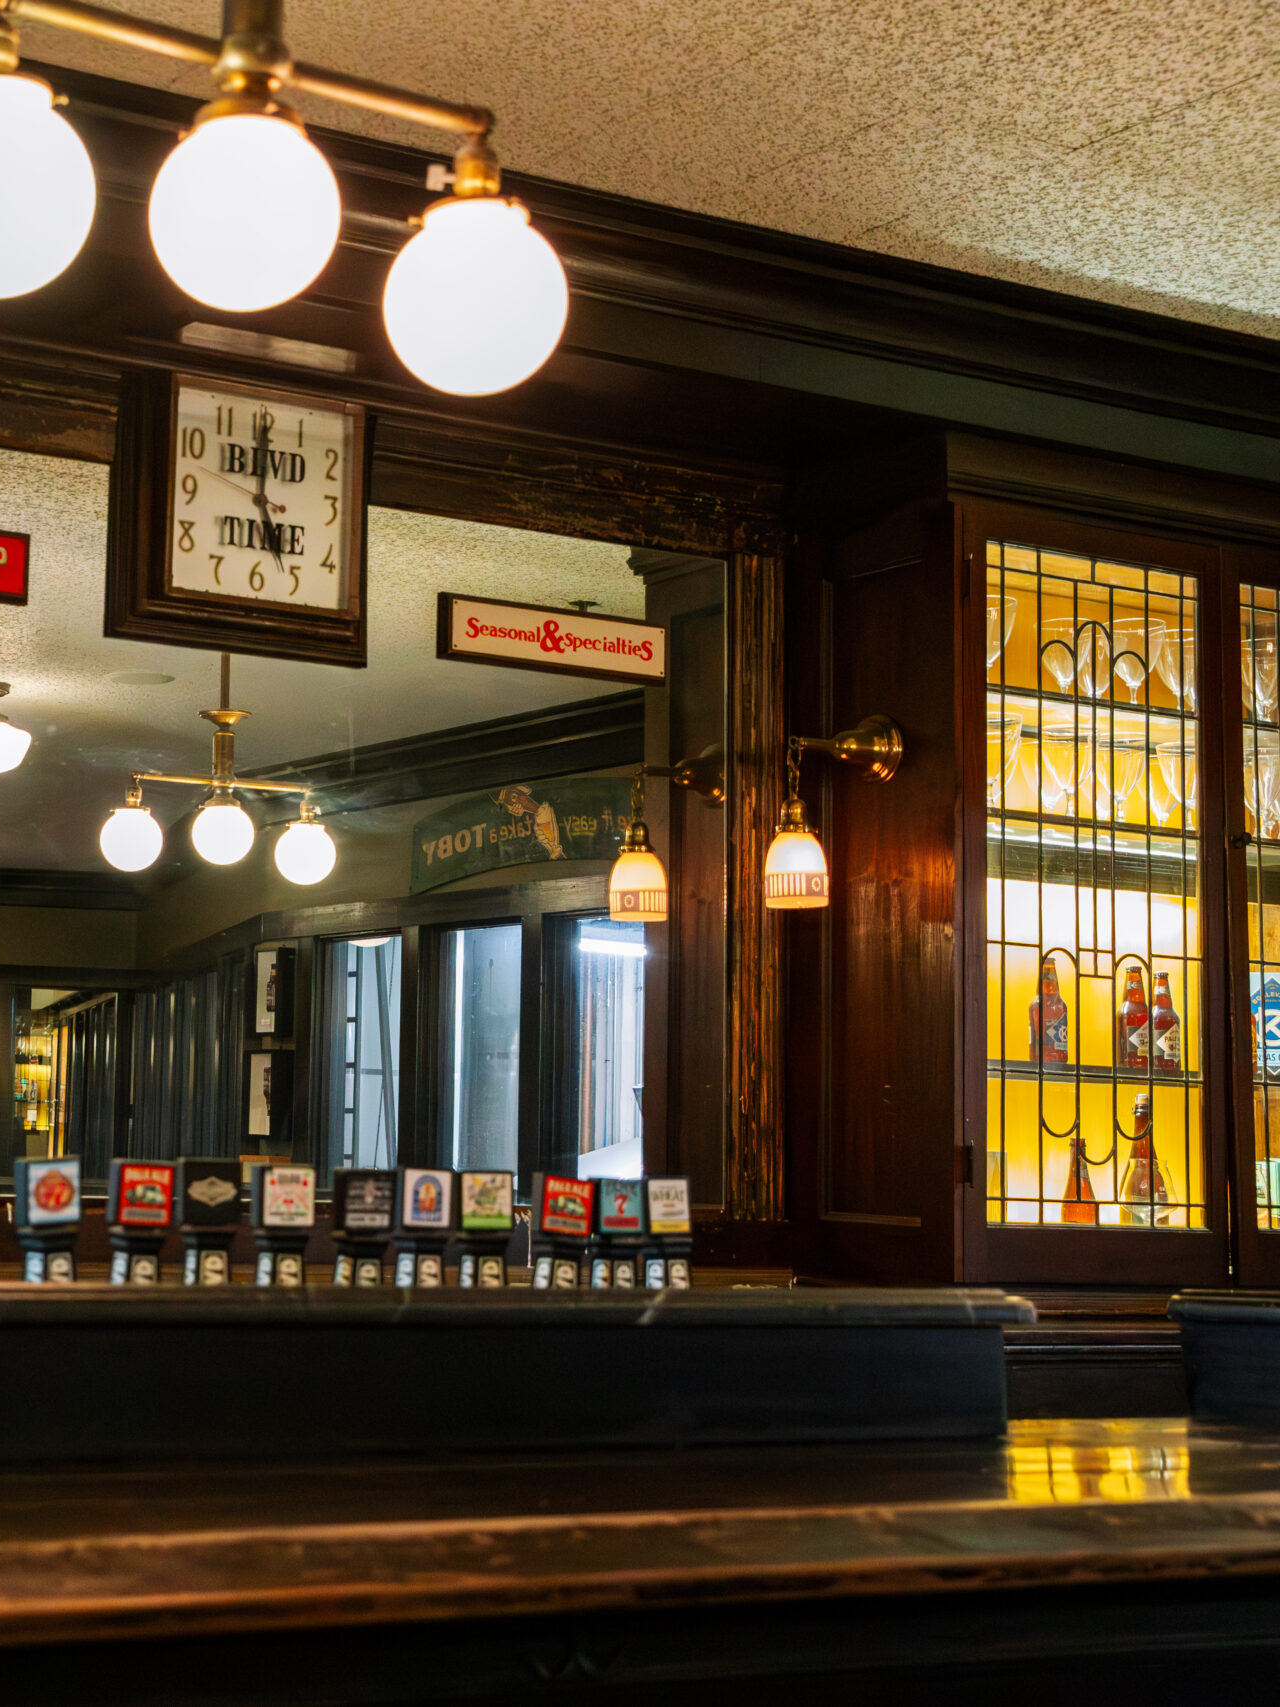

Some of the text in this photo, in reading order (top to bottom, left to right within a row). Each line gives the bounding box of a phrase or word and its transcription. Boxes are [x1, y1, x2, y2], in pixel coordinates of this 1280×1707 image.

[216, 404, 232, 437] 11
[251, 407, 275, 444] 12
[296, 418, 304, 448] 1
[181, 426, 206, 460] 10
[227, 442, 307, 484] BLVD
[325, 448, 339, 482] 2
[182, 473, 198, 506] 9
[323, 494, 339, 527] 3
[177, 519, 195, 553] 8
[223, 515, 305, 556] TIME
[208, 553, 225, 586] 7
[319, 543, 337, 575] 4
[248, 560, 265, 592] 6
[288, 565, 302, 597] 5
[464, 616, 541, 643] Seasonal
[540, 619, 566, 654] &
